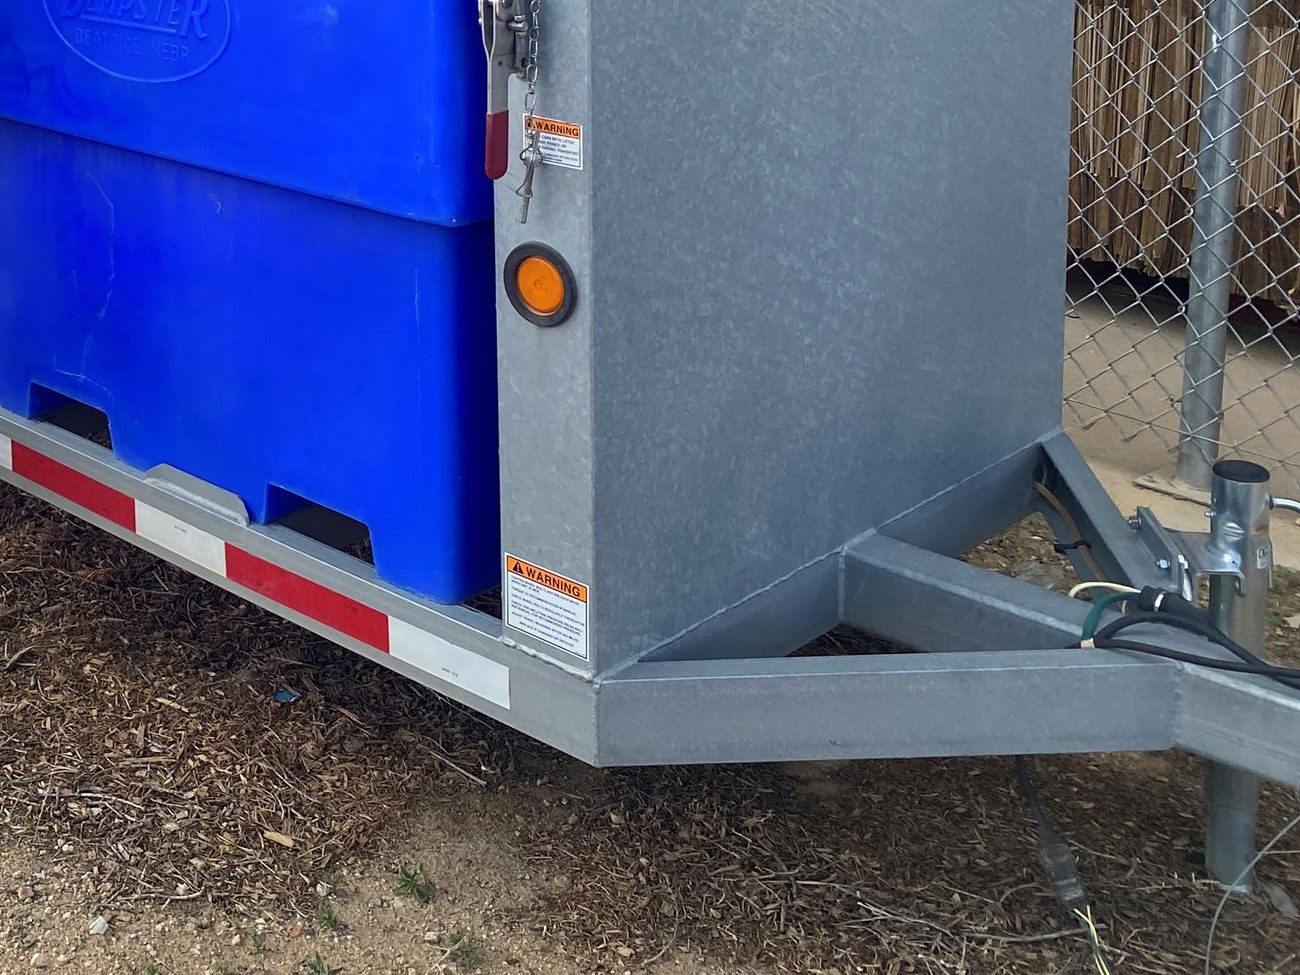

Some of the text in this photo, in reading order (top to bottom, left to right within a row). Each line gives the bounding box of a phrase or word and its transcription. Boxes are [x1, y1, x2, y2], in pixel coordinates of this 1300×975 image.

[75, 27, 140, 56] BEATRICE
[536, 121, 579, 137] WARNING
[526, 566, 580, 597] WARNING
